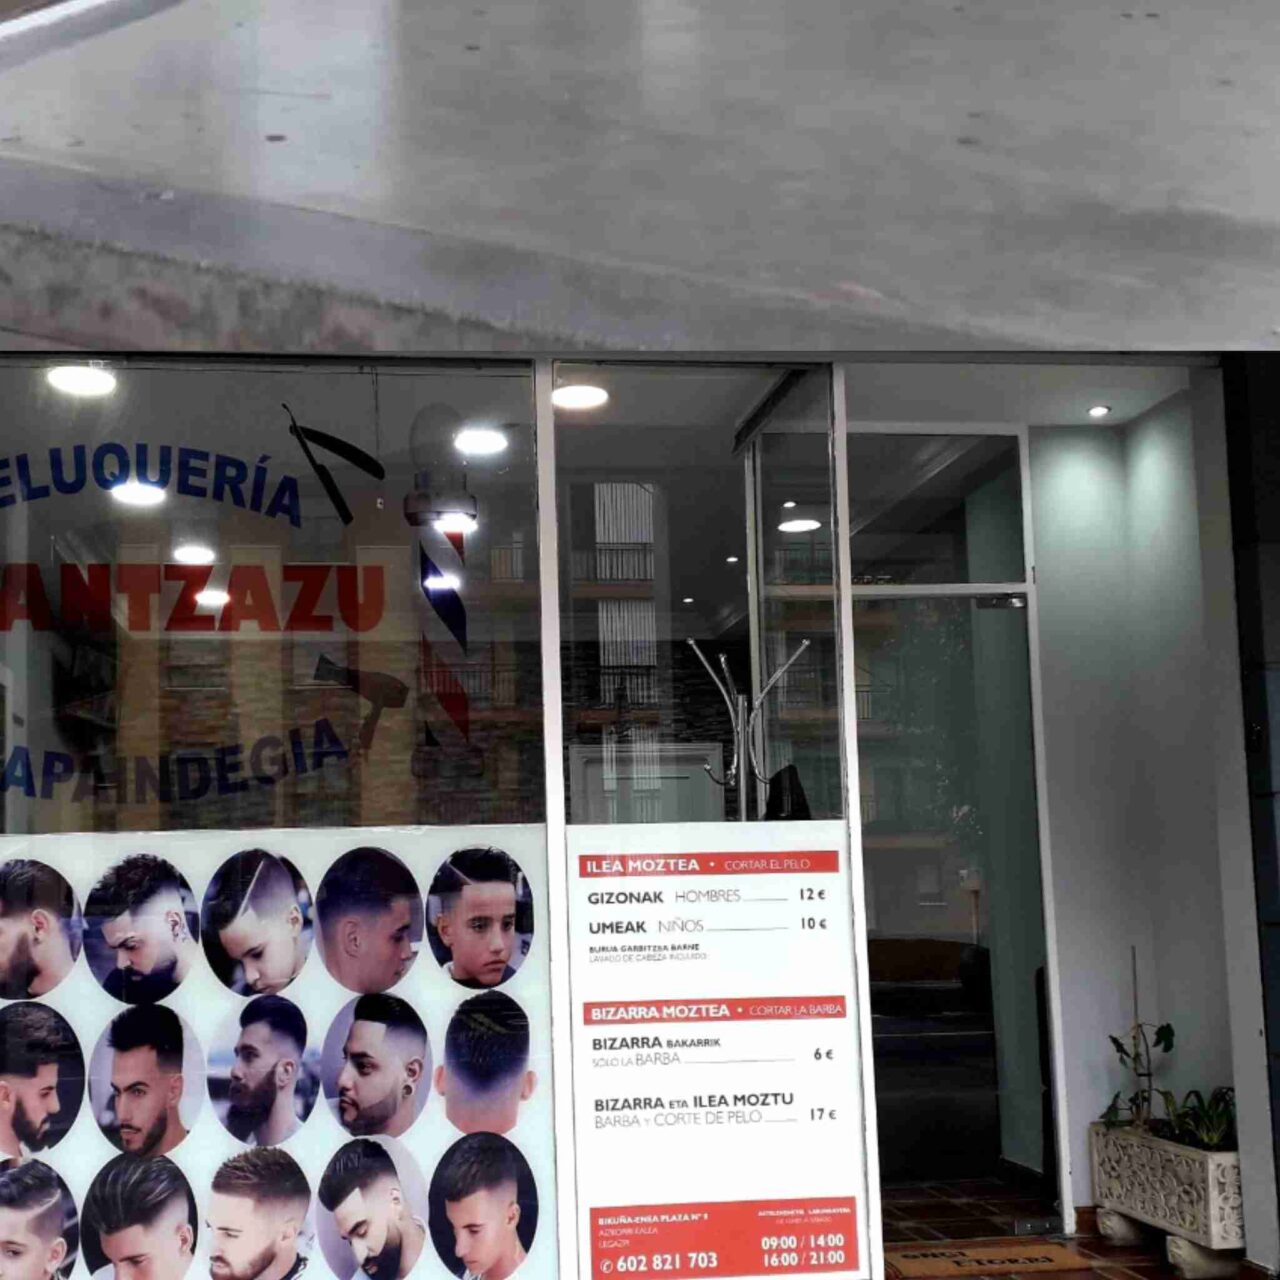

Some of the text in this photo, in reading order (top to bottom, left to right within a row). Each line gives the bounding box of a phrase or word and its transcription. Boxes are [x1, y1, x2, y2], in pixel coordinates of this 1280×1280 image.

[586, 859, 624, 873] ILEA
[628, 858, 700, 872] MOZTEA
[724, 859, 769, 871] CORTAR
[783, 858, 811, 870] PELO
[587, 891, 664, 905] GIZONAK
[675, 889, 741, 903] HOMBRES
[799, 887, 814, 901] 12
[589, 921, 647, 934] UMEAK
[658, 917, 704, 933] NIÑOS
[800, 917, 816, 930] 10
[591, 1006, 660, 1020] BIZARRA
[662, 1004, 730, 1018] MOZTEA
[749, 1005, 792, 1016] CORTAR
[809, 1003, 842, 1014] BARBA
[592, 1036, 721, 1051] BIZARRA BAKARRIK
[635, 1052, 681, 1066] BARBA
[813, 1048, 822, 1060] 6
[594, 1093, 795, 1112] BIZARRA ETA ILEA MOZTU
[594, 1114, 641, 1128] BARBA
[654, 1112, 702, 1126] CORTE
[705, 1110, 725, 1124] DE
[727, 1108, 762, 1123] PELO
[810, 1107, 825, 1121] 17
[616, 1251, 718, 1272] 602 821 703
